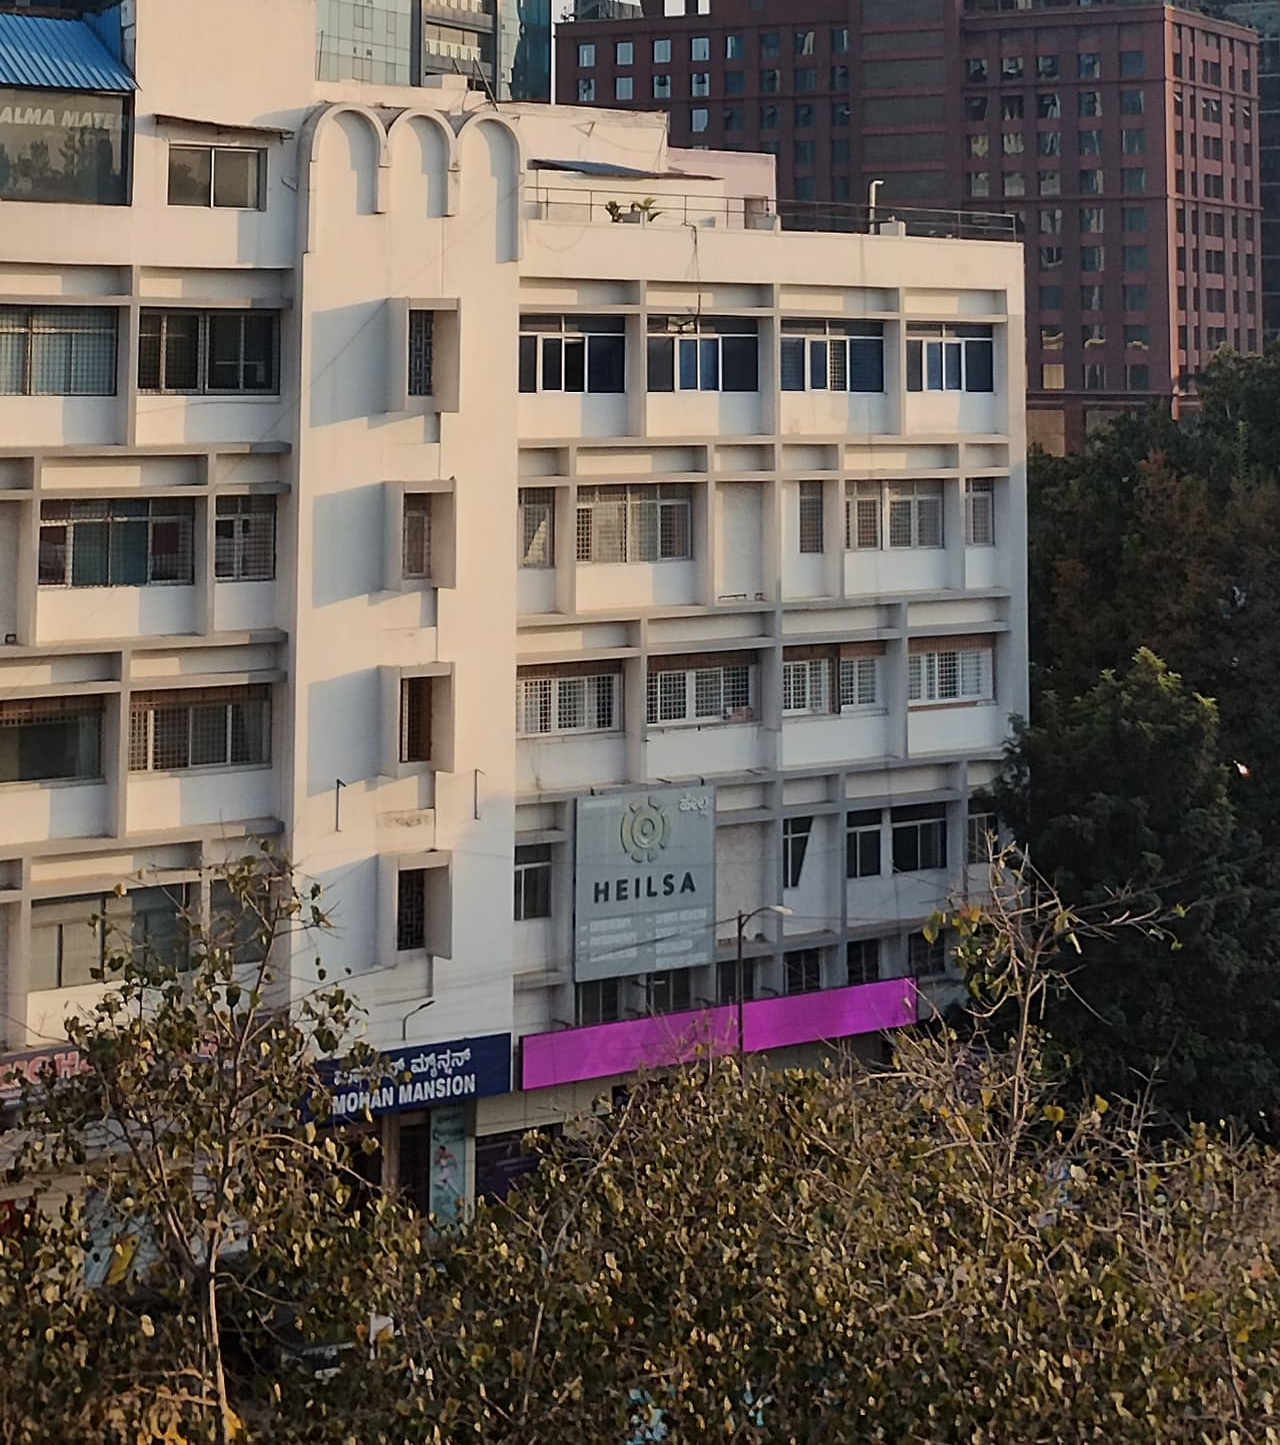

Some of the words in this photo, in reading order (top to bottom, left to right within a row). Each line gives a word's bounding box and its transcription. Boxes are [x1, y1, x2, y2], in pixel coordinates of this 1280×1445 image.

[61, 110, 117, 129] MATE
[593, 871, 696, 904] HEILSA
[332, 1085, 394, 1115] MOHAN
[399, 1073, 476, 1105] MANSION
